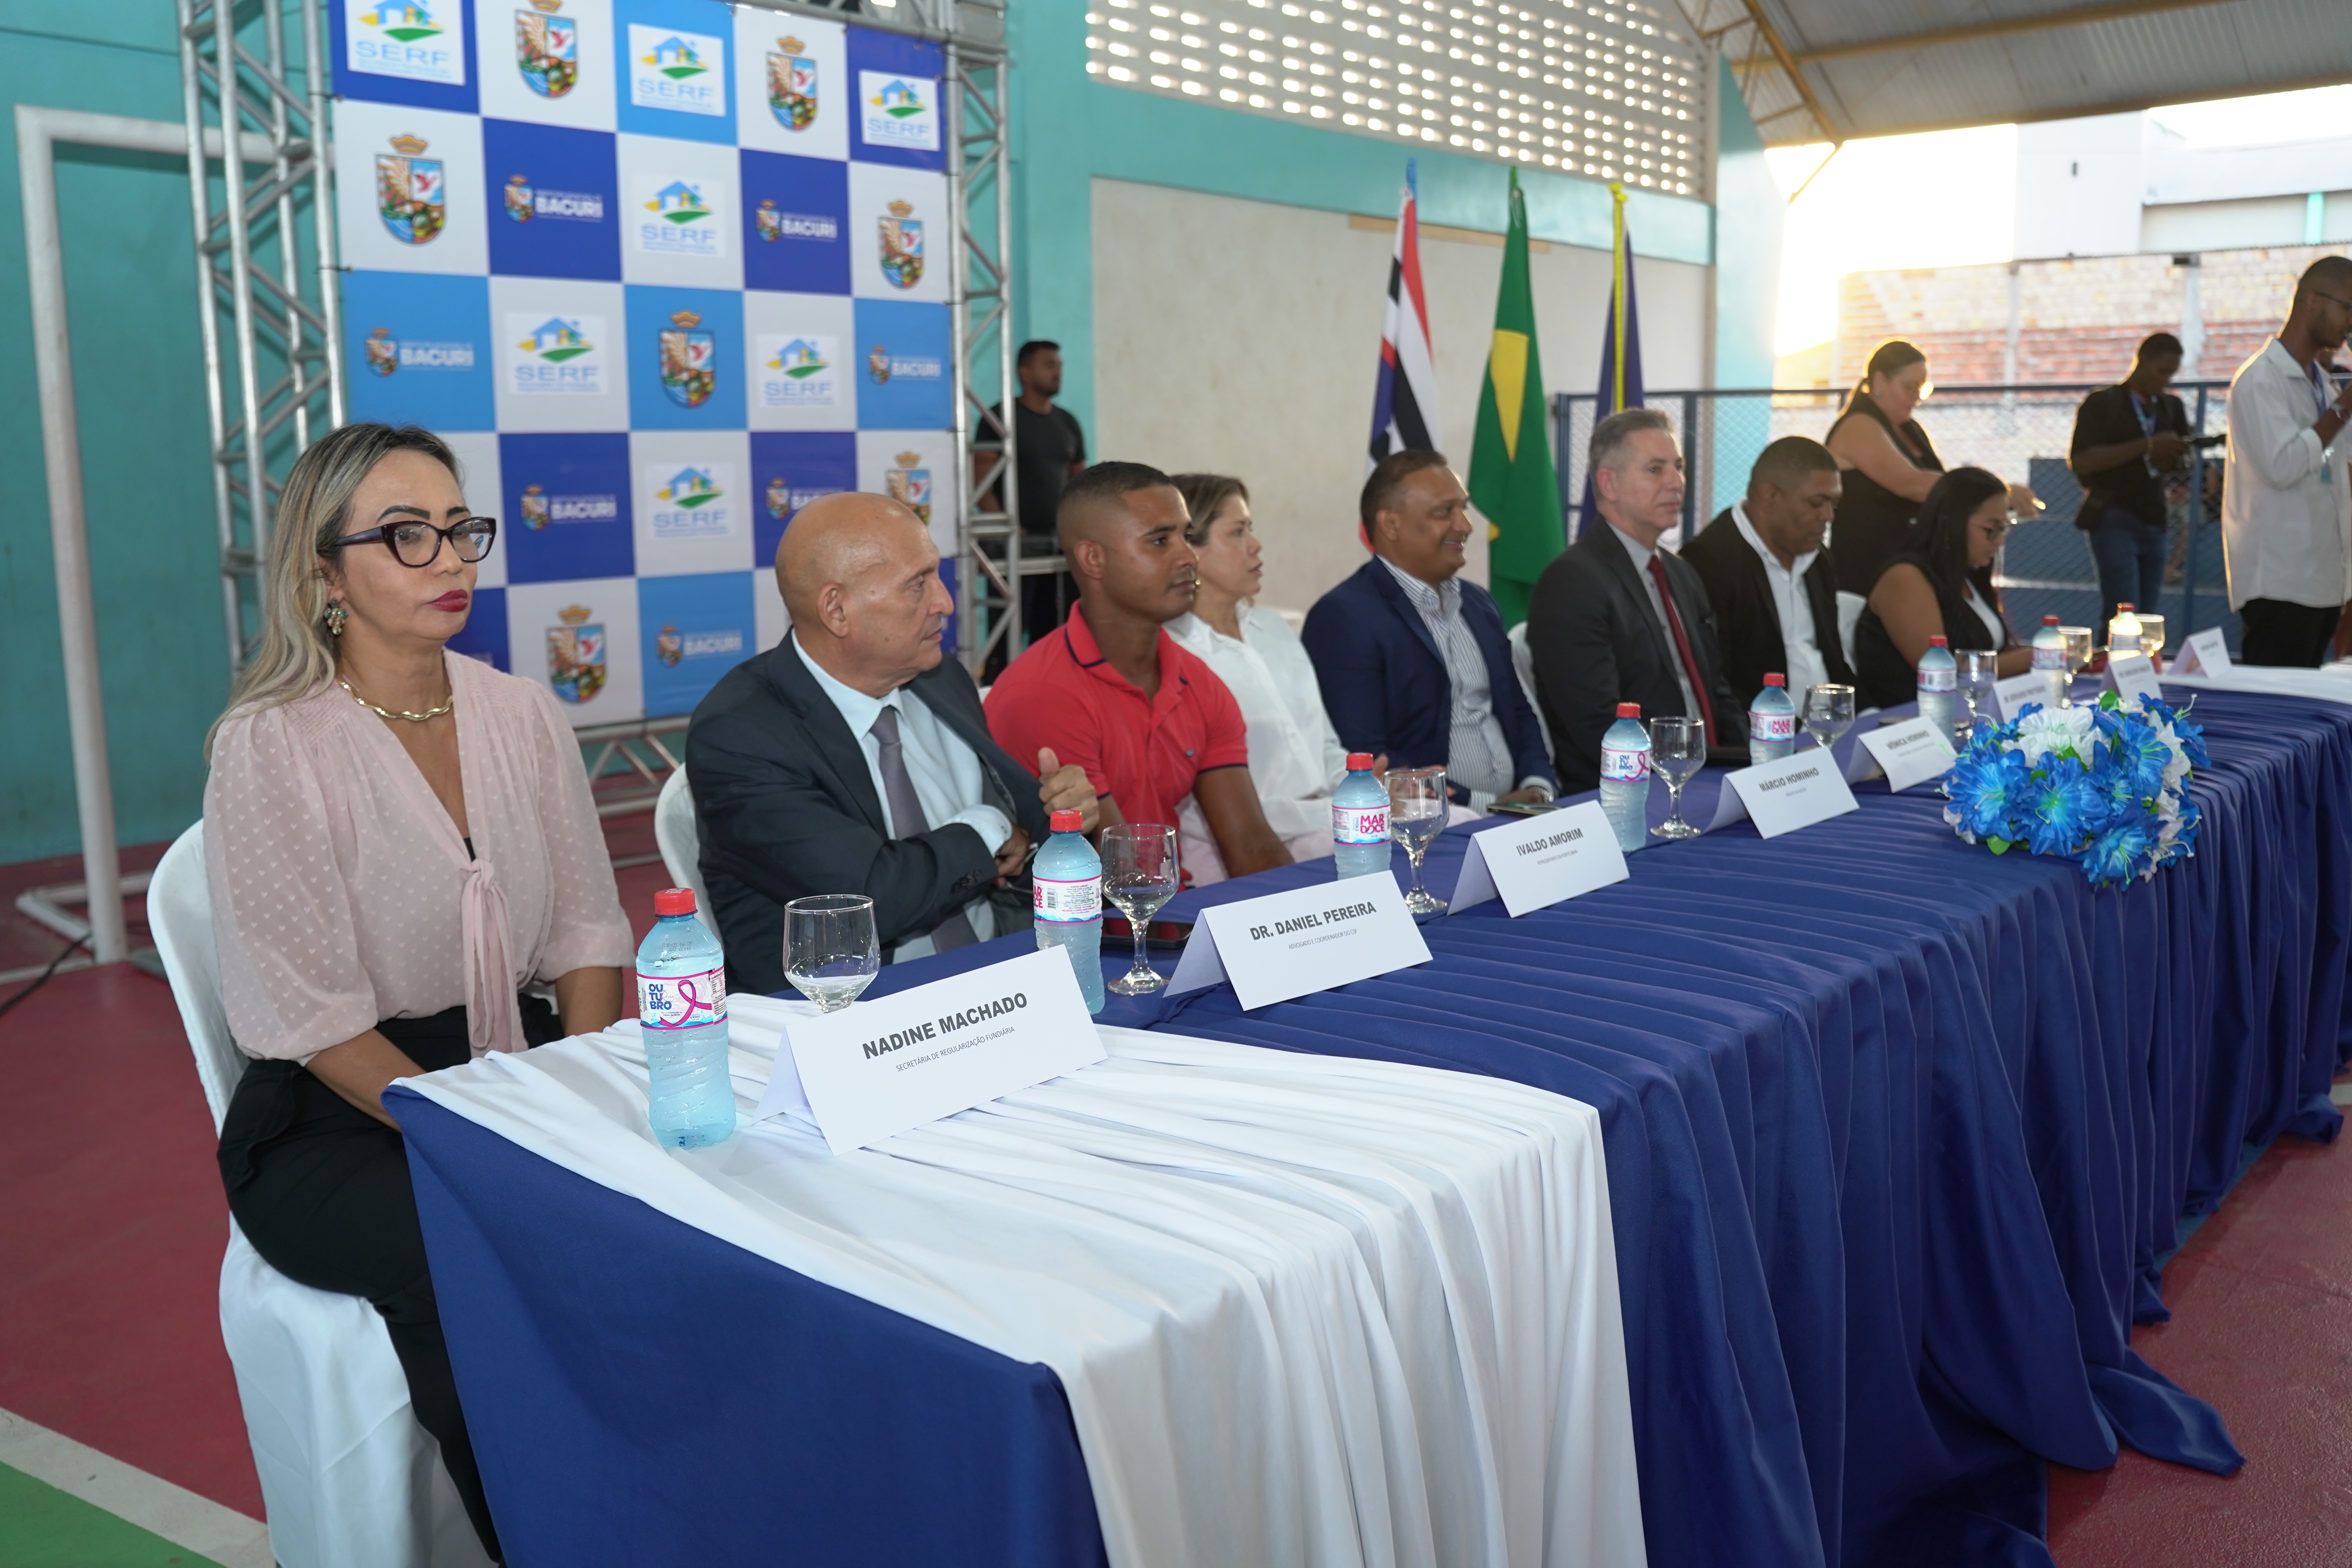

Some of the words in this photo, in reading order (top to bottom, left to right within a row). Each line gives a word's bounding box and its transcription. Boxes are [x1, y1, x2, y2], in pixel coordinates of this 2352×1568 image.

[356, 41, 450, 66] SERF
[638, 78, 713, 101] SERF
[868, 118, 931, 138] SERF
[535, 198, 604, 219] BACURI
[641, 224, 717, 244] SERF
[781, 218, 838, 239] BACURI
[399, 349, 474, 367] BACURI
[515, 366, 598, 382] SERF
[891, 361, 941, 377] BACURI
[765, 381, 832, 397] SERF
[550, 503, 617, 520] BACURI
[653, 510, 727, 529] SERF
[684, 635, 743, 655] BACURI
[1886, 738, 1908, 750] MÔNICA
[1759, 776, 1786, 792] MÁRCIO
[1786, 767, 1819, 785] HOMINHO
[1360, 813, 1385, 825] MAR
[1360, 823, 1385, 834] DOCE
[1516, 838, 1548, 857] IVALDO
[1549, 828, 1584, 847] AMORIM
[1033, 885, 1042, 898] AR
[1249, 925, 1274, 940] DR.
[1274, 914, 1323, 935] DANIEL
[1323, 902, 1377, 924] PEREIRA
[1289, 939, 1311, 950] ADVOGADO
[1314, 932, 1344, 944] COORDENADOR
[649, 984, 663, 992] OU
[649, 992, 662, 1001] TU
[650, 1001, 672, 1010] BRO
[862, 1022, 936, 1060] NADINE
[938, 993, 1027, 1034] MACHADO
[896, 1054, 931, 1072] SECRETÁRIA
[931, 1052, 940, 1060] DE
[940, 1036, 985, 1057] REGULARIZAÇÃO
[985, 1026, 1015, 1042] FUNDIÁRIA
